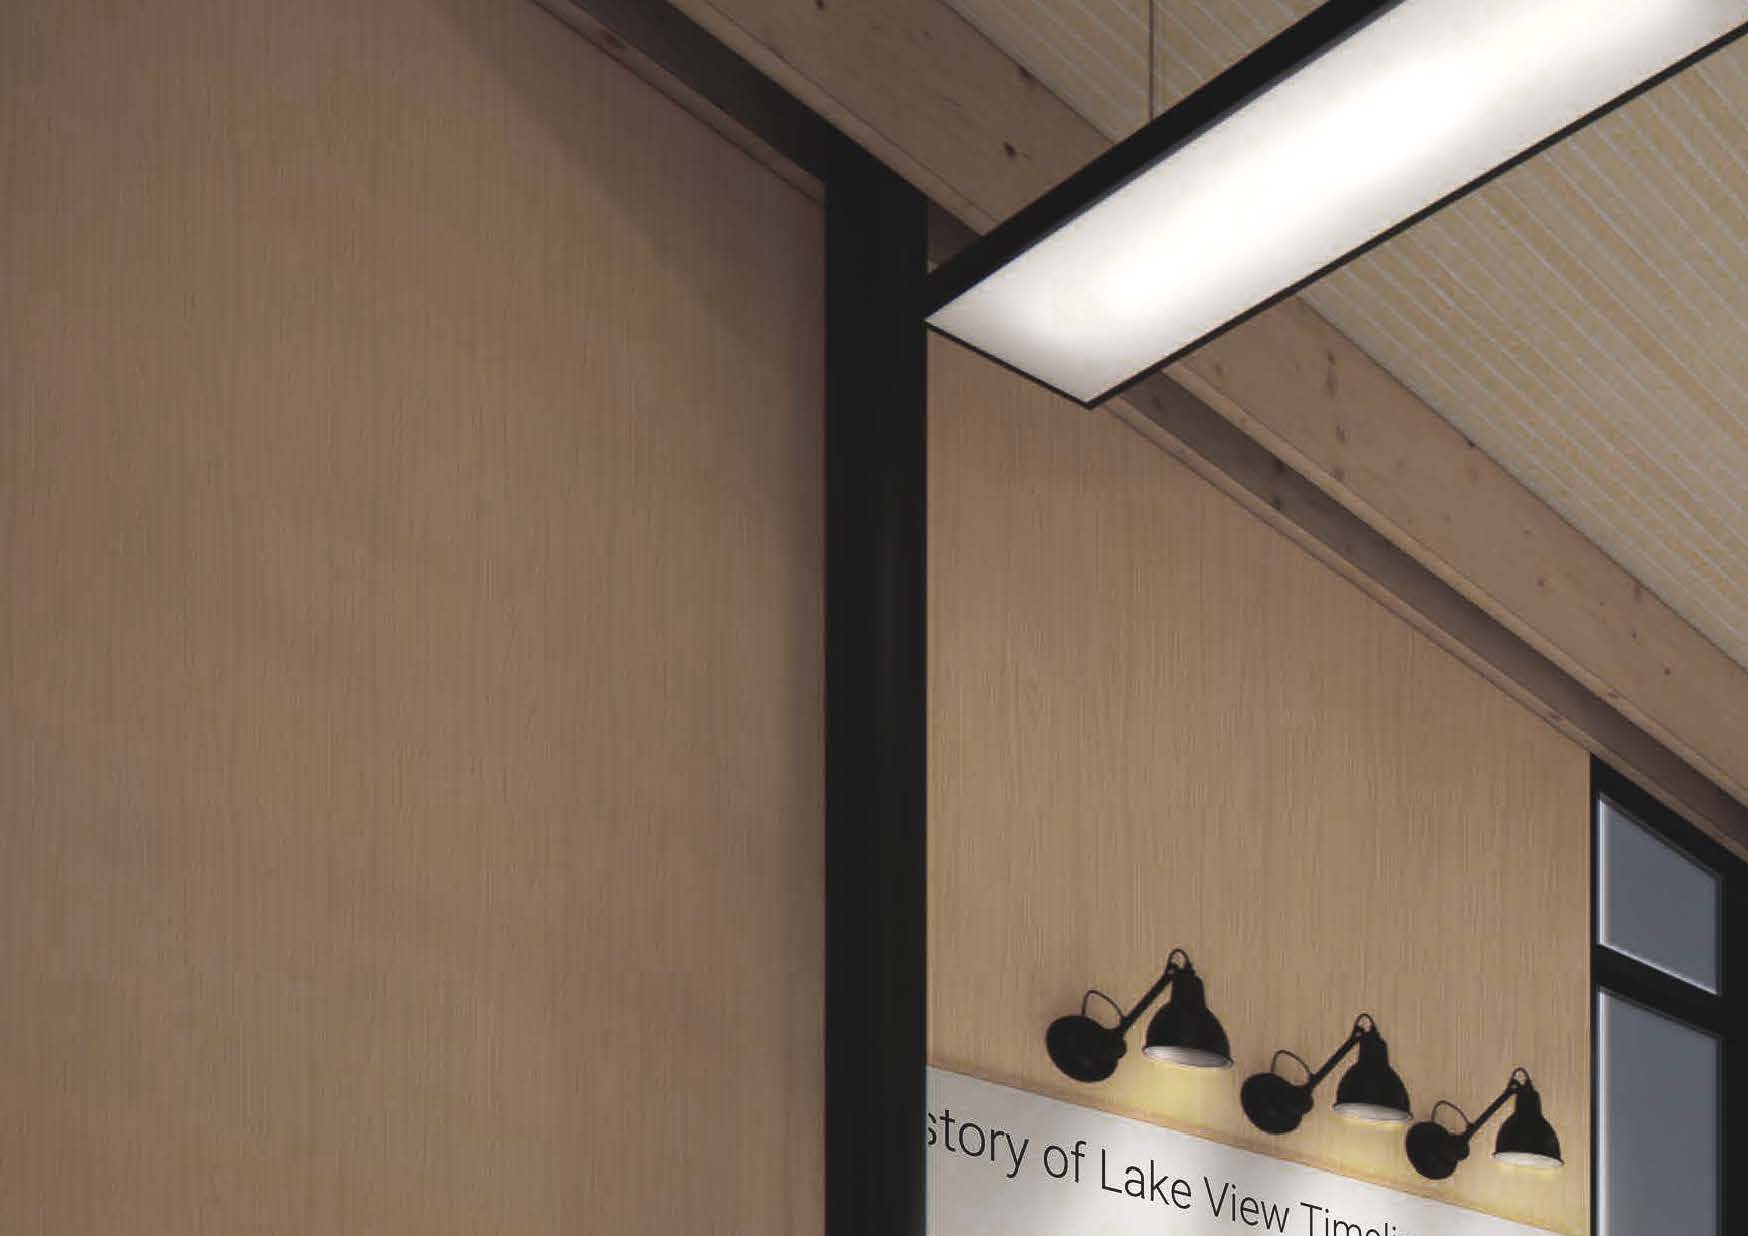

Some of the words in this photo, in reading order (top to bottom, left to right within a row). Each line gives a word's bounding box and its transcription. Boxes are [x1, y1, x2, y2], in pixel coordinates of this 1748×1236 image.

[928, 1108, 1029, 1179] story
[1043, 1140, 1087, 1183] of
[1100, 1148, 1192, 1210] Lake
[1203, 1176, 1291, 1234] View
